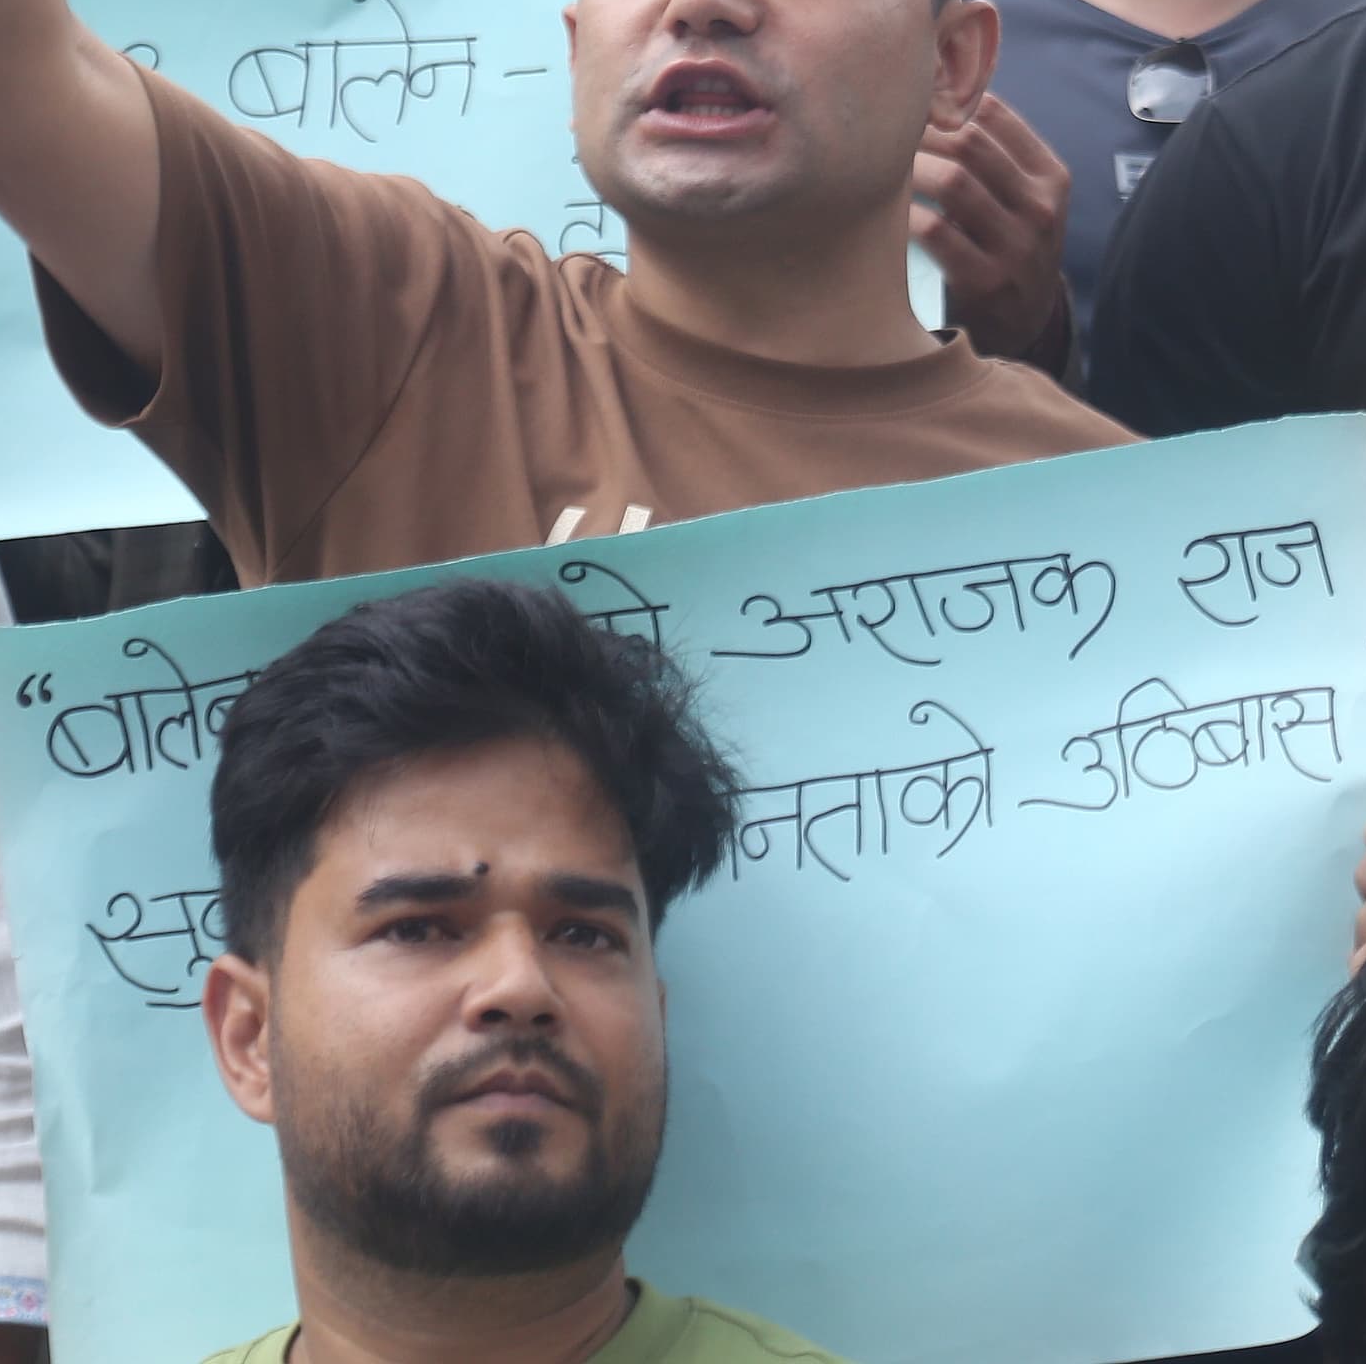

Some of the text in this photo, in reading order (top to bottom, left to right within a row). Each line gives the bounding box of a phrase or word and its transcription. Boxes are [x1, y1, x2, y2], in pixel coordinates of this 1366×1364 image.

[709, 551, 1117, 666] अराजक
[1177, 520, 1336, 627] राज
[717, 698, 995, 882] नताको
